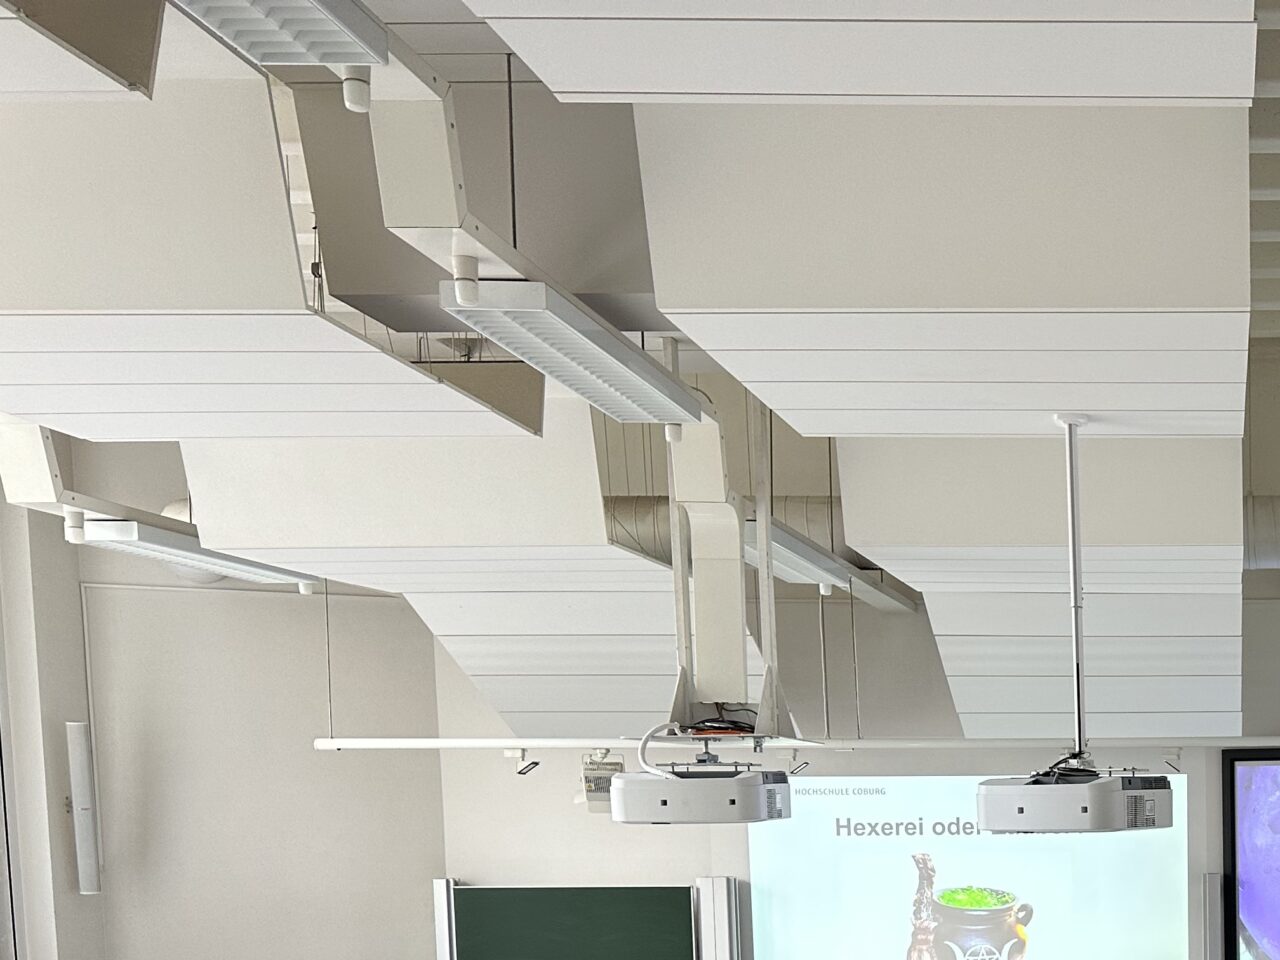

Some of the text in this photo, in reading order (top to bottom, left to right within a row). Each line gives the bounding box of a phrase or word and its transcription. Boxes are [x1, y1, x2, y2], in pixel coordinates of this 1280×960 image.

[795, 787, 886, 796] HOCHSCHULE COBURG
[836, 817, 924, 836] Hexerei
